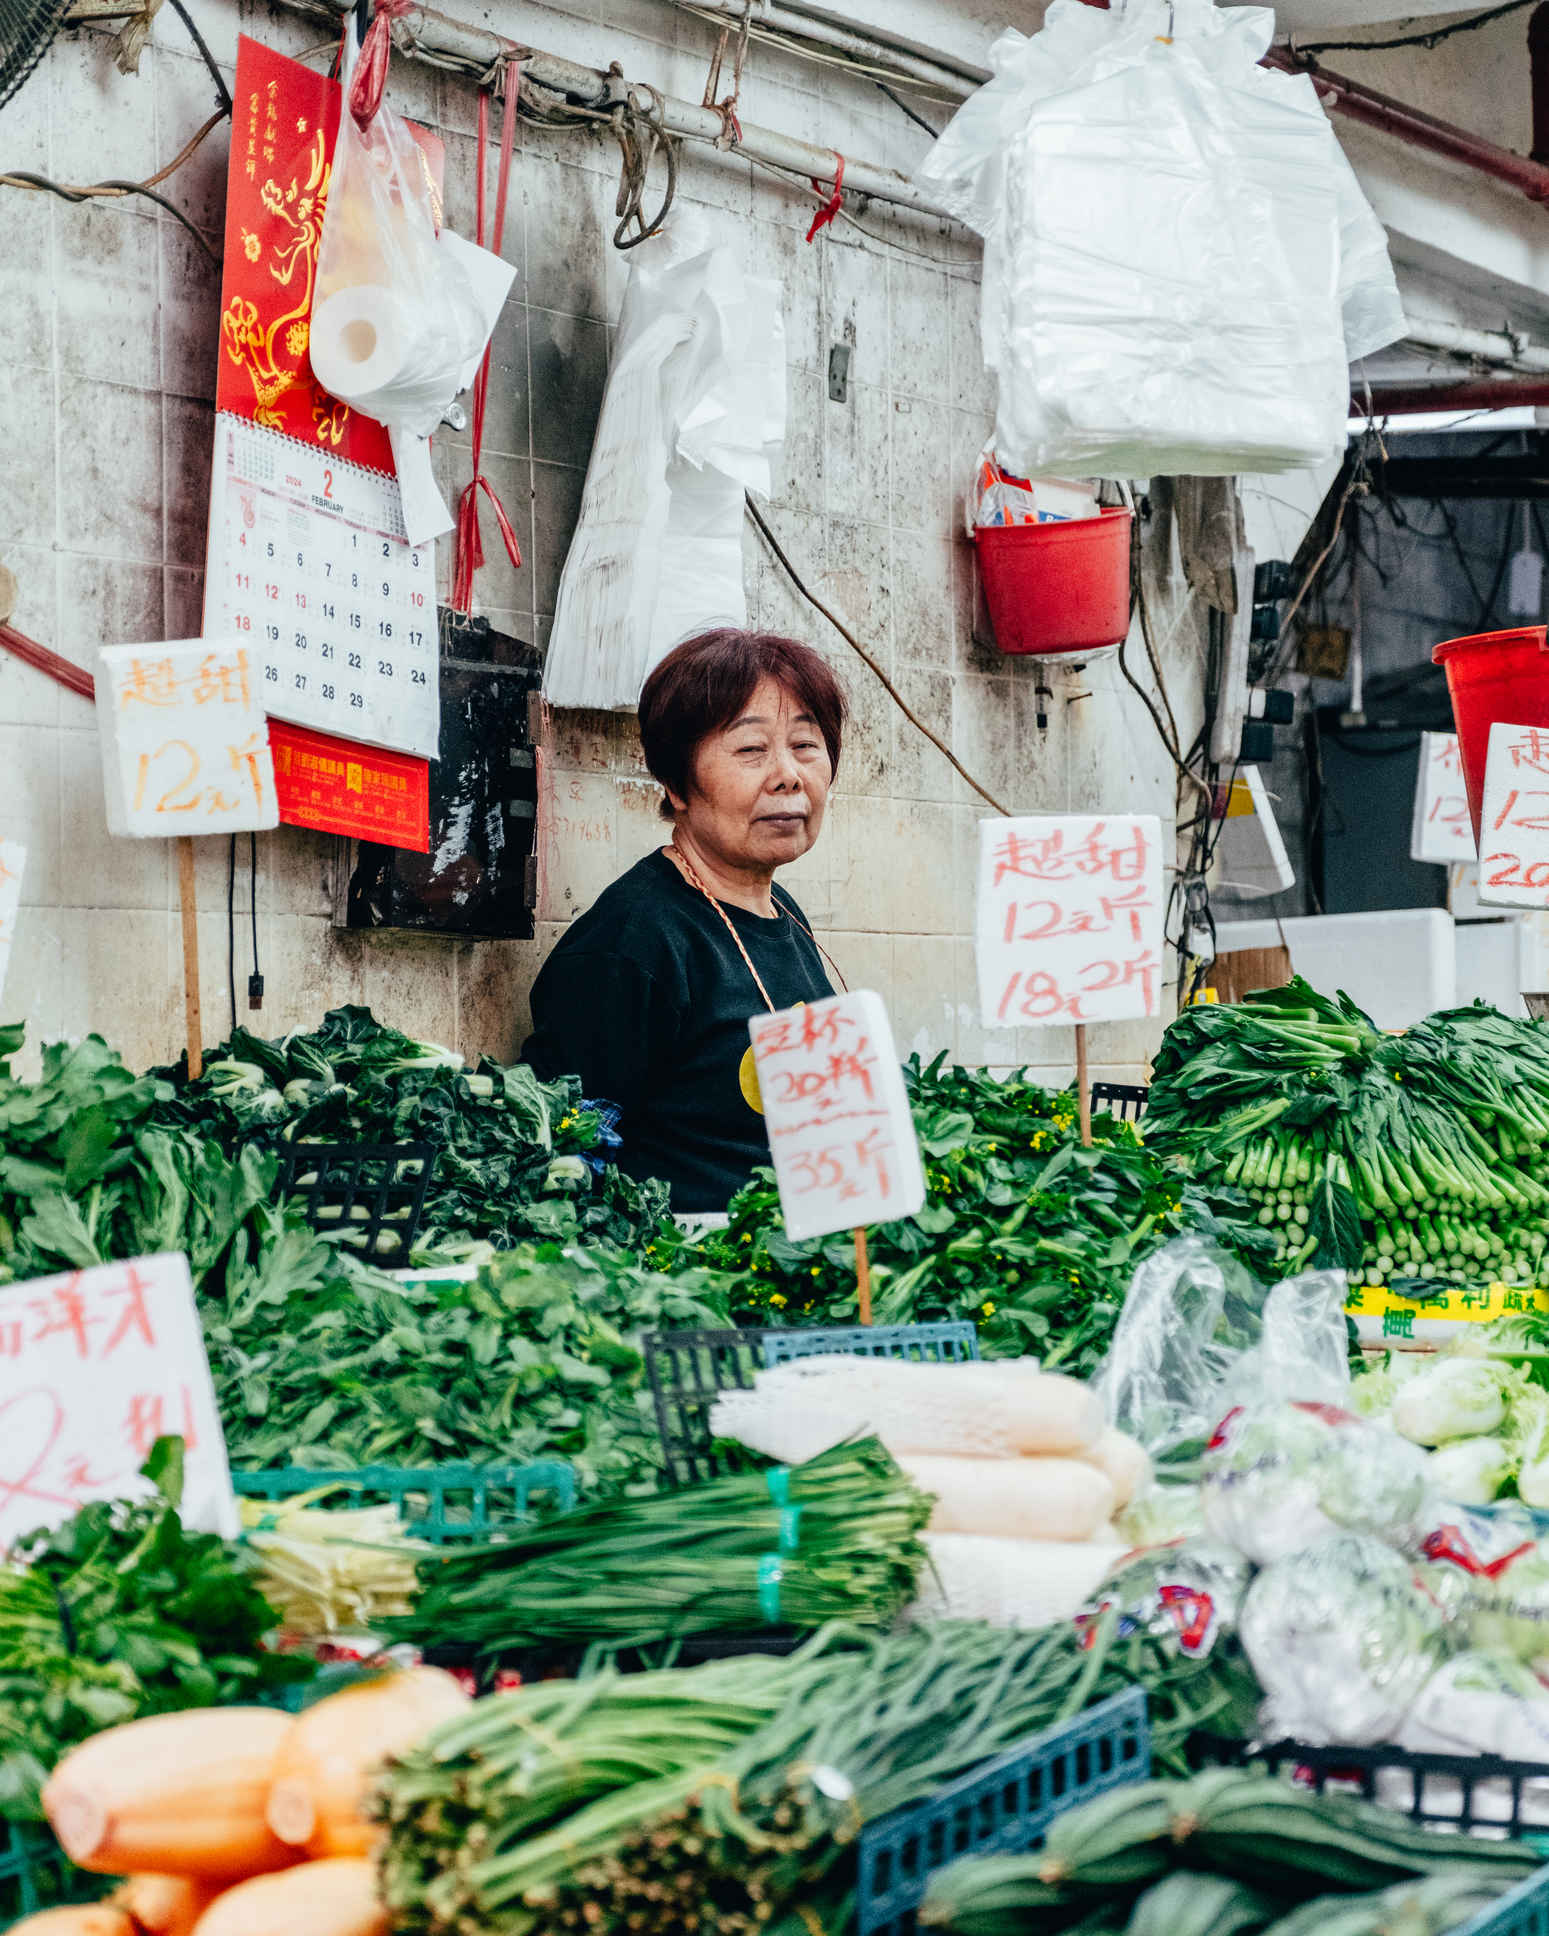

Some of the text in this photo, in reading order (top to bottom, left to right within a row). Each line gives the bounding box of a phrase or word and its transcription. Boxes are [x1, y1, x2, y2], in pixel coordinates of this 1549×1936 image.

[311, 494, 344, 514] FEBRUARY
[323, 469, 334, 498] 2
[267, 543, 275, 557] 5
[297, 553, 303, 567] 6
[325, 564, 332, 577] 7
[351, 574, 358, 588] 8
[382, 582, 390, 596] 9
[410, 592, 423, 607] 10
[382, 543, 390, 557] 2
[412, 553, 419, 567] 3
[236, 573, 422, 647] 11 12 13 14 15 16 17
[235, 614, 425, 685] 18 19 20 21 22 23 24
[265, 665, 363, 708] 26 27 28 29
